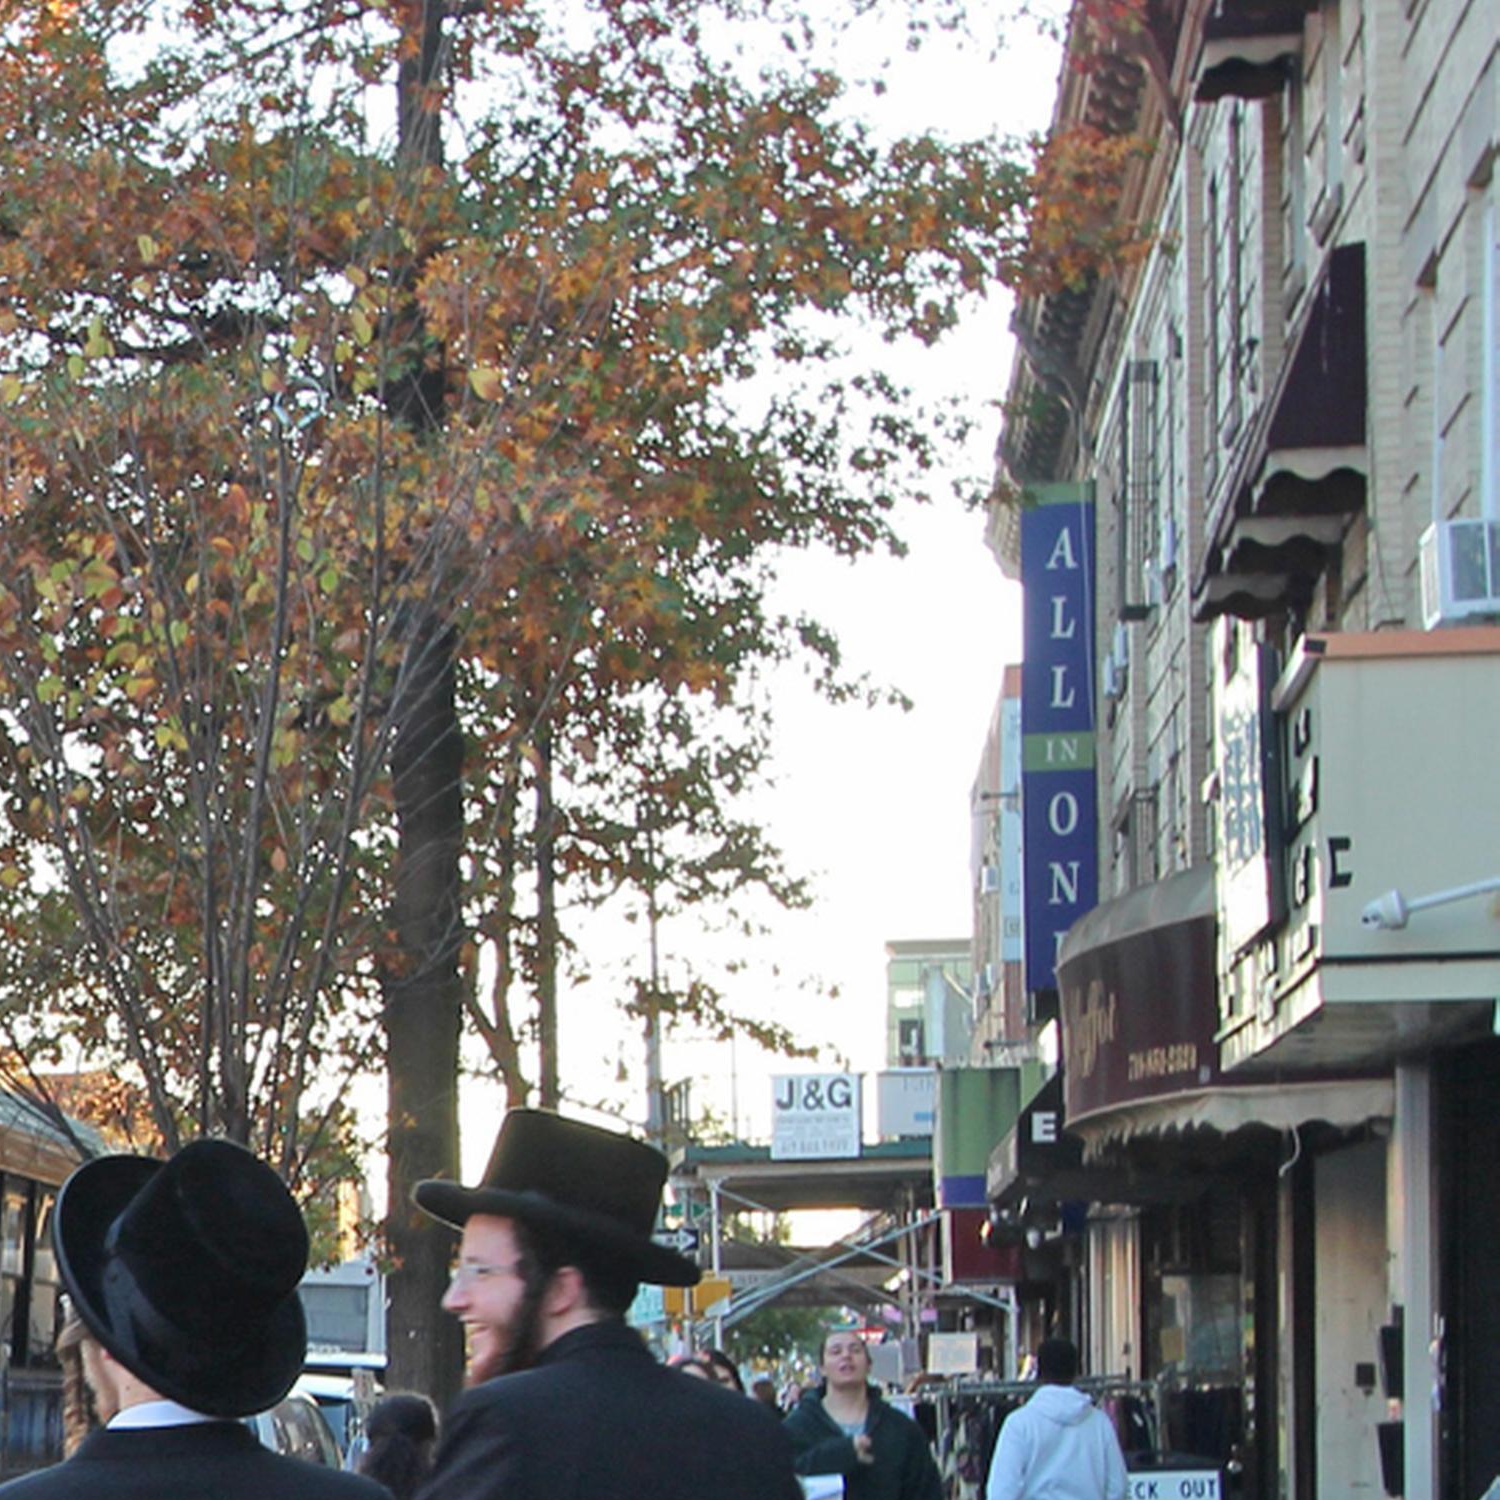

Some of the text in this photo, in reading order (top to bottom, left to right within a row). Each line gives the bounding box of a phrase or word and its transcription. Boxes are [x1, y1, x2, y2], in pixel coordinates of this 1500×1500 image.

[1045, 527, 1078, 708] ALL
[1046, 738, 1078, 763] IN
[776, 1078, 852, 1111] J&G
[1127, 1478, 1215, 1500] ECK OUT
